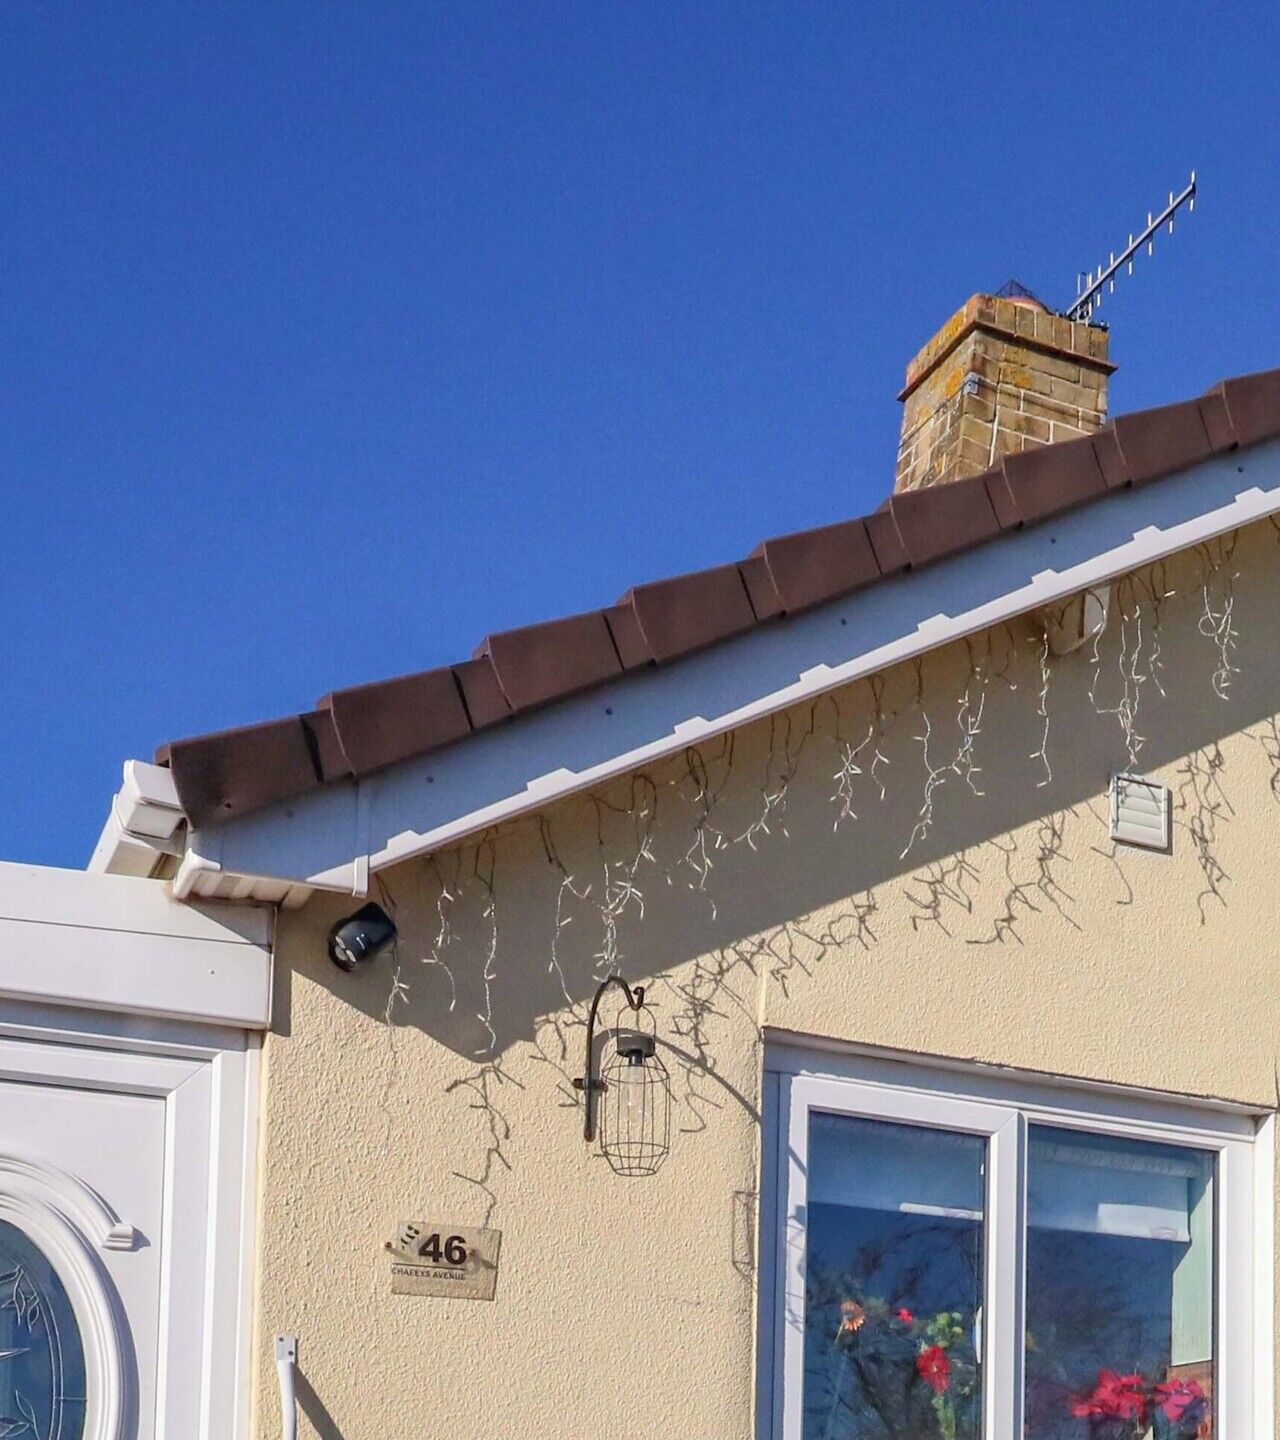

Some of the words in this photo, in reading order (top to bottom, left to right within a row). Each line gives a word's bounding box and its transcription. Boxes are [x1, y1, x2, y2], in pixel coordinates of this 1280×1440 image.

[418, 1233, 467, 1265] 46
[391, 1267, 430, 1277] CHAFEYS
[432, 1270, 466, 1280] AVENUE
